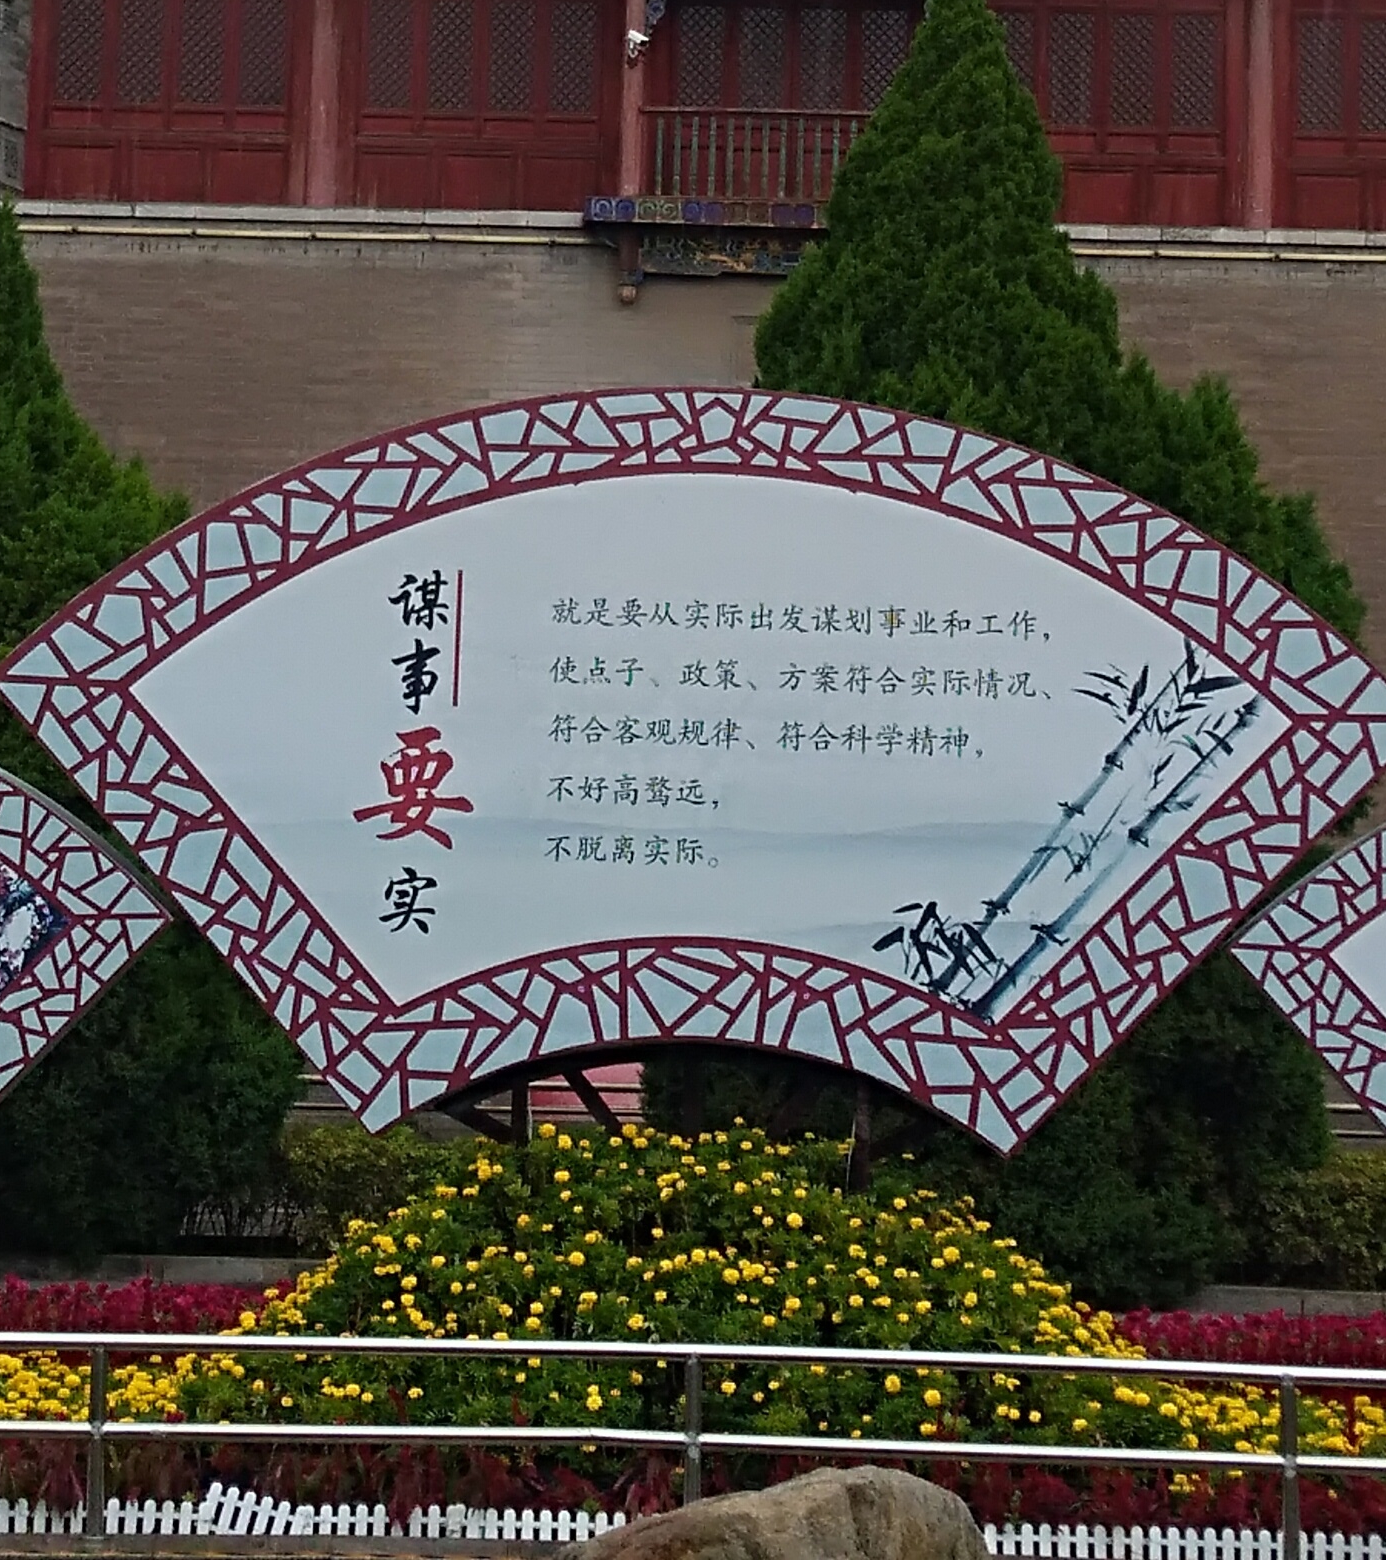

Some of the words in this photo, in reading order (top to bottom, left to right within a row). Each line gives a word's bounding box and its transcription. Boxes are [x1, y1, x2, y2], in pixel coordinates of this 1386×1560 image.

[551, 597, 1052, 642] 就是要从实际出发谋划事业和工作，
[353, 569, 475, 934] 谋事要实
[548, 714, 985, 760] 符合客观规律、符合科学精神，
[544, 834, 720, 869] 不脱离实际。
